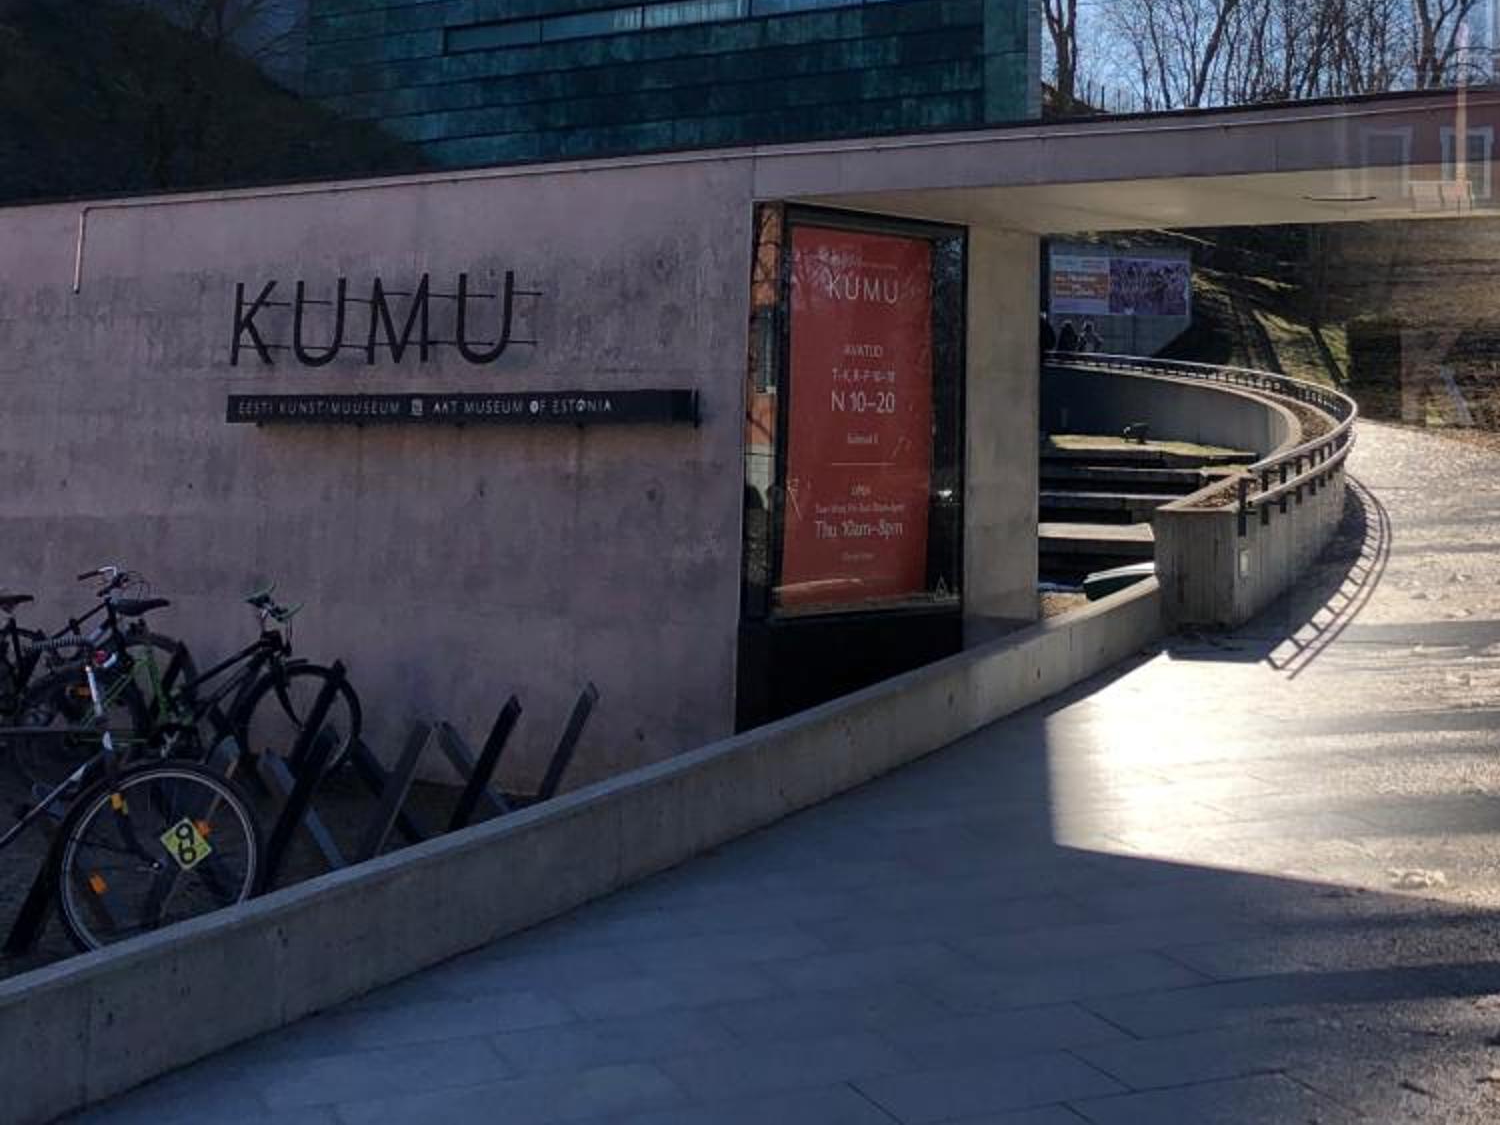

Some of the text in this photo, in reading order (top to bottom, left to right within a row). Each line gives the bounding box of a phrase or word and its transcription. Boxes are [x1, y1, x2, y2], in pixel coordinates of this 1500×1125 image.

[829, 270, 898, 304] KUMU
[230, 271, 514, 366] KUMU
[464, 399, 523, 415] MUSEUM
[529, 399, 547, 414] OF
[552, 397, 611, 414] ESTONIA
[831, 390, 846, 412] N
